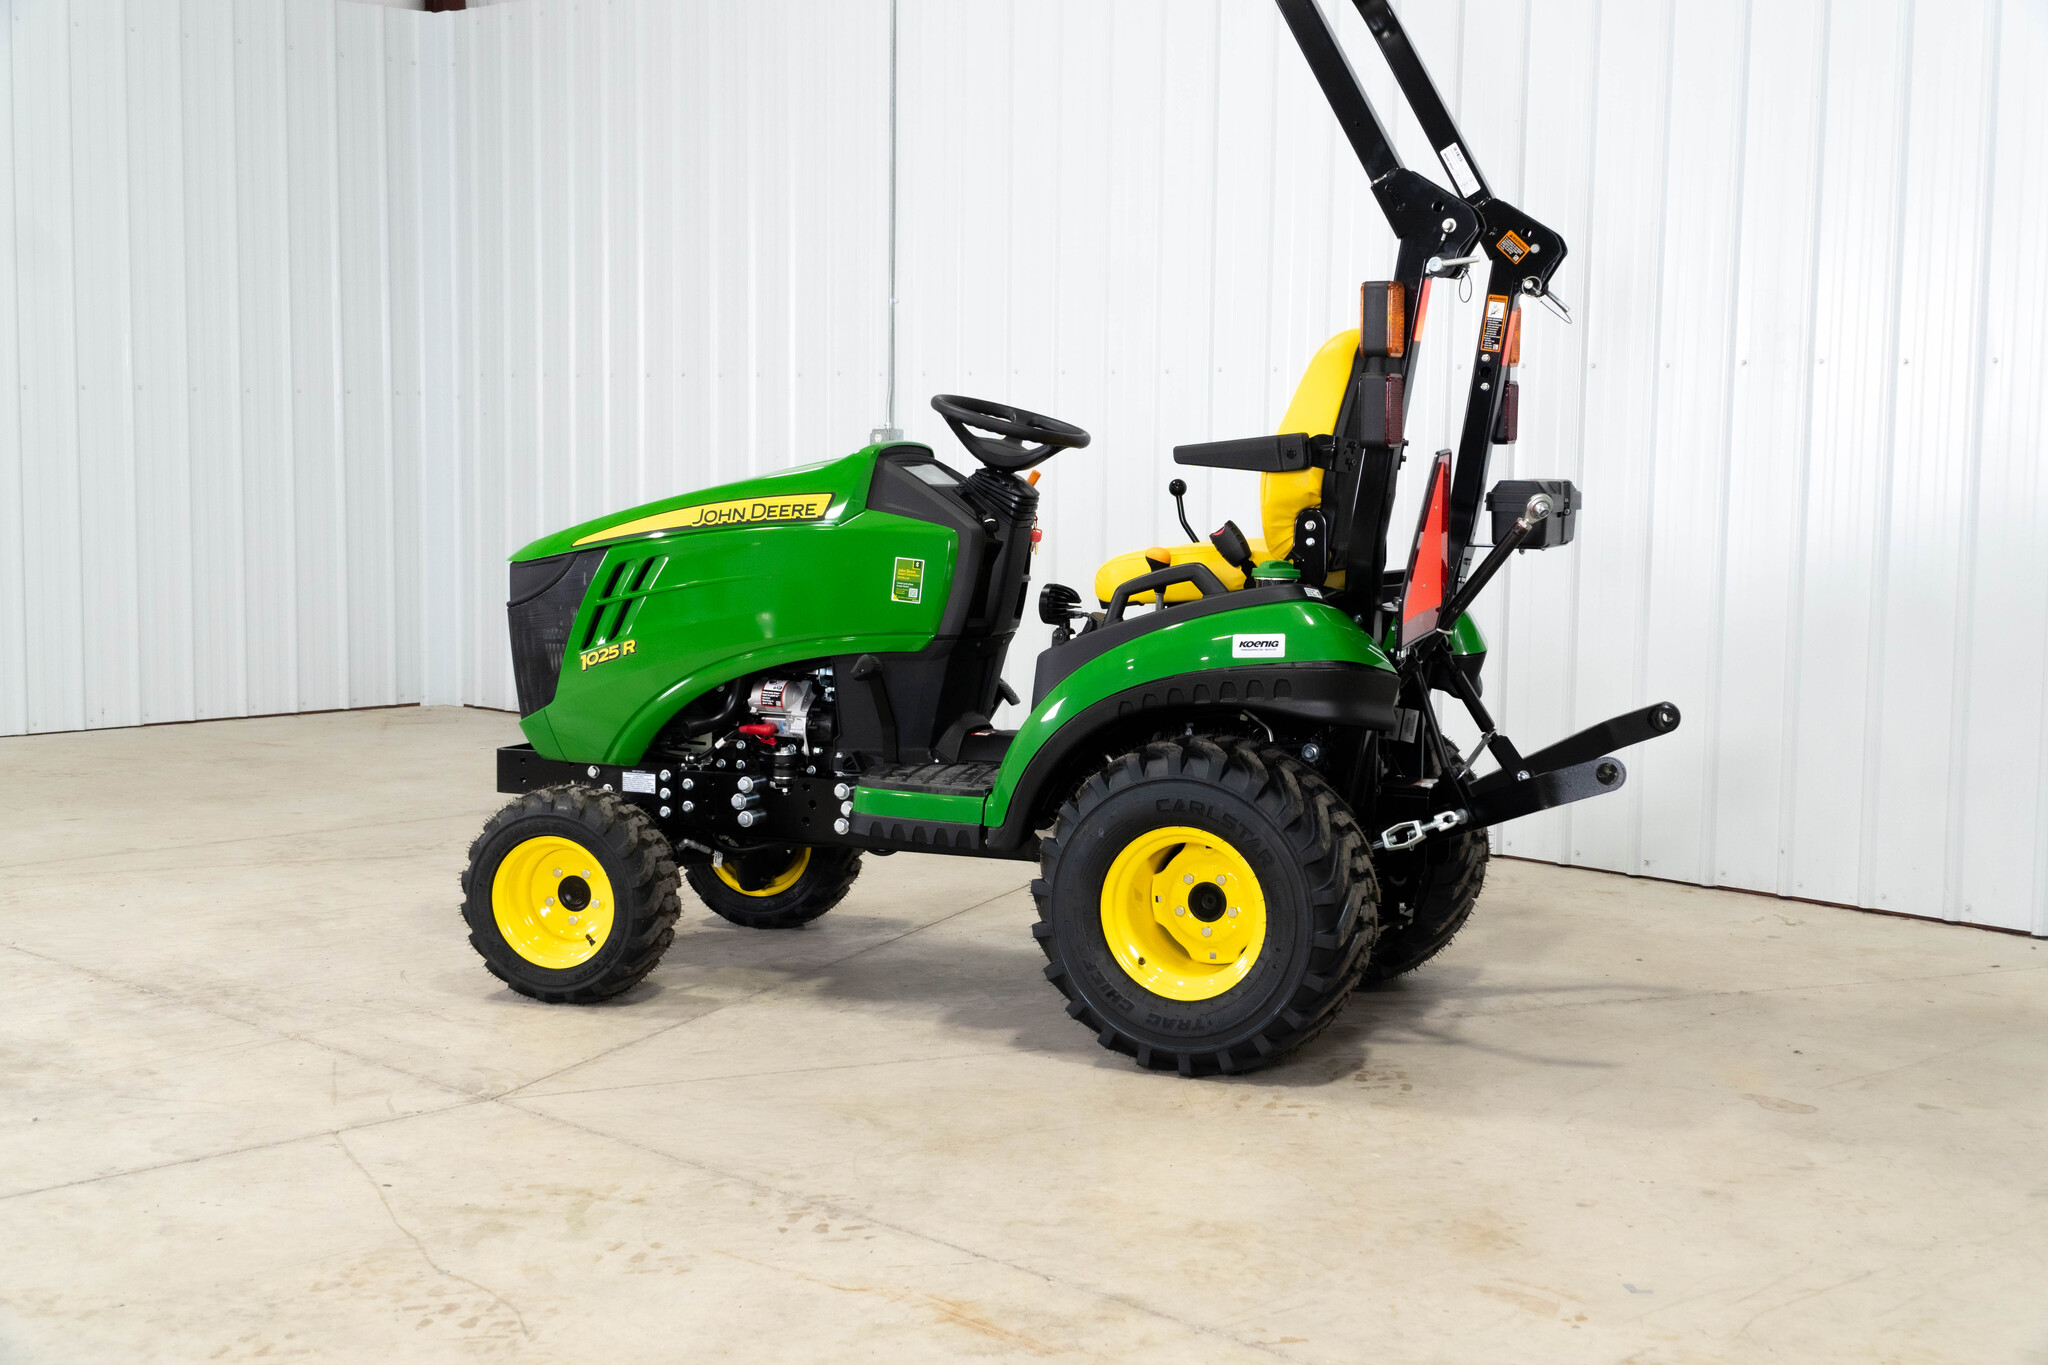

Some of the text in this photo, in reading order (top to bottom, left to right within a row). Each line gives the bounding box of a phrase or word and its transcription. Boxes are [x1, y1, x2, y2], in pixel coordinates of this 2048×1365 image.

[692, 503, 817, 525] JOHN DEERE
[1155, 798, 1275, 869] CARLSTAR
[1145, 1012, 1205, 1032] TRAC
